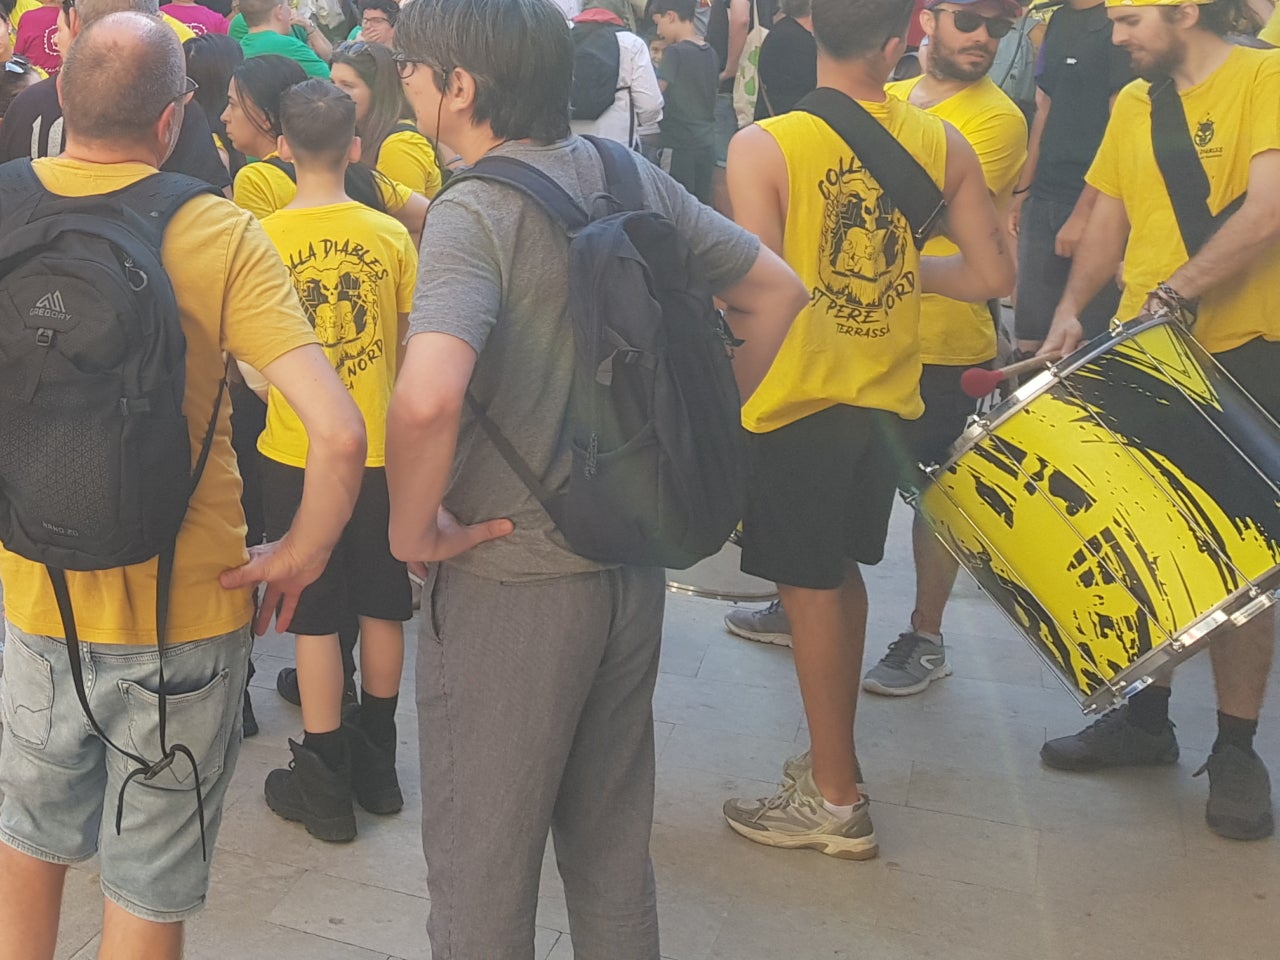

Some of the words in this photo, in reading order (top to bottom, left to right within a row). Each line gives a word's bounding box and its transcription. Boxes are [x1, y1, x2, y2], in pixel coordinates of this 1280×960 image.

[817, 155, 863, 201] COLL
[284, 241, 317, 277] LLA
[319, 238, 389, 282] DIABLES
[29, 307, 73, 321] GREGORY
[824, 301, 881, 324] PERE
[884, 270, 915, 317] ORD
[346, 339, 384, 378] NORD
